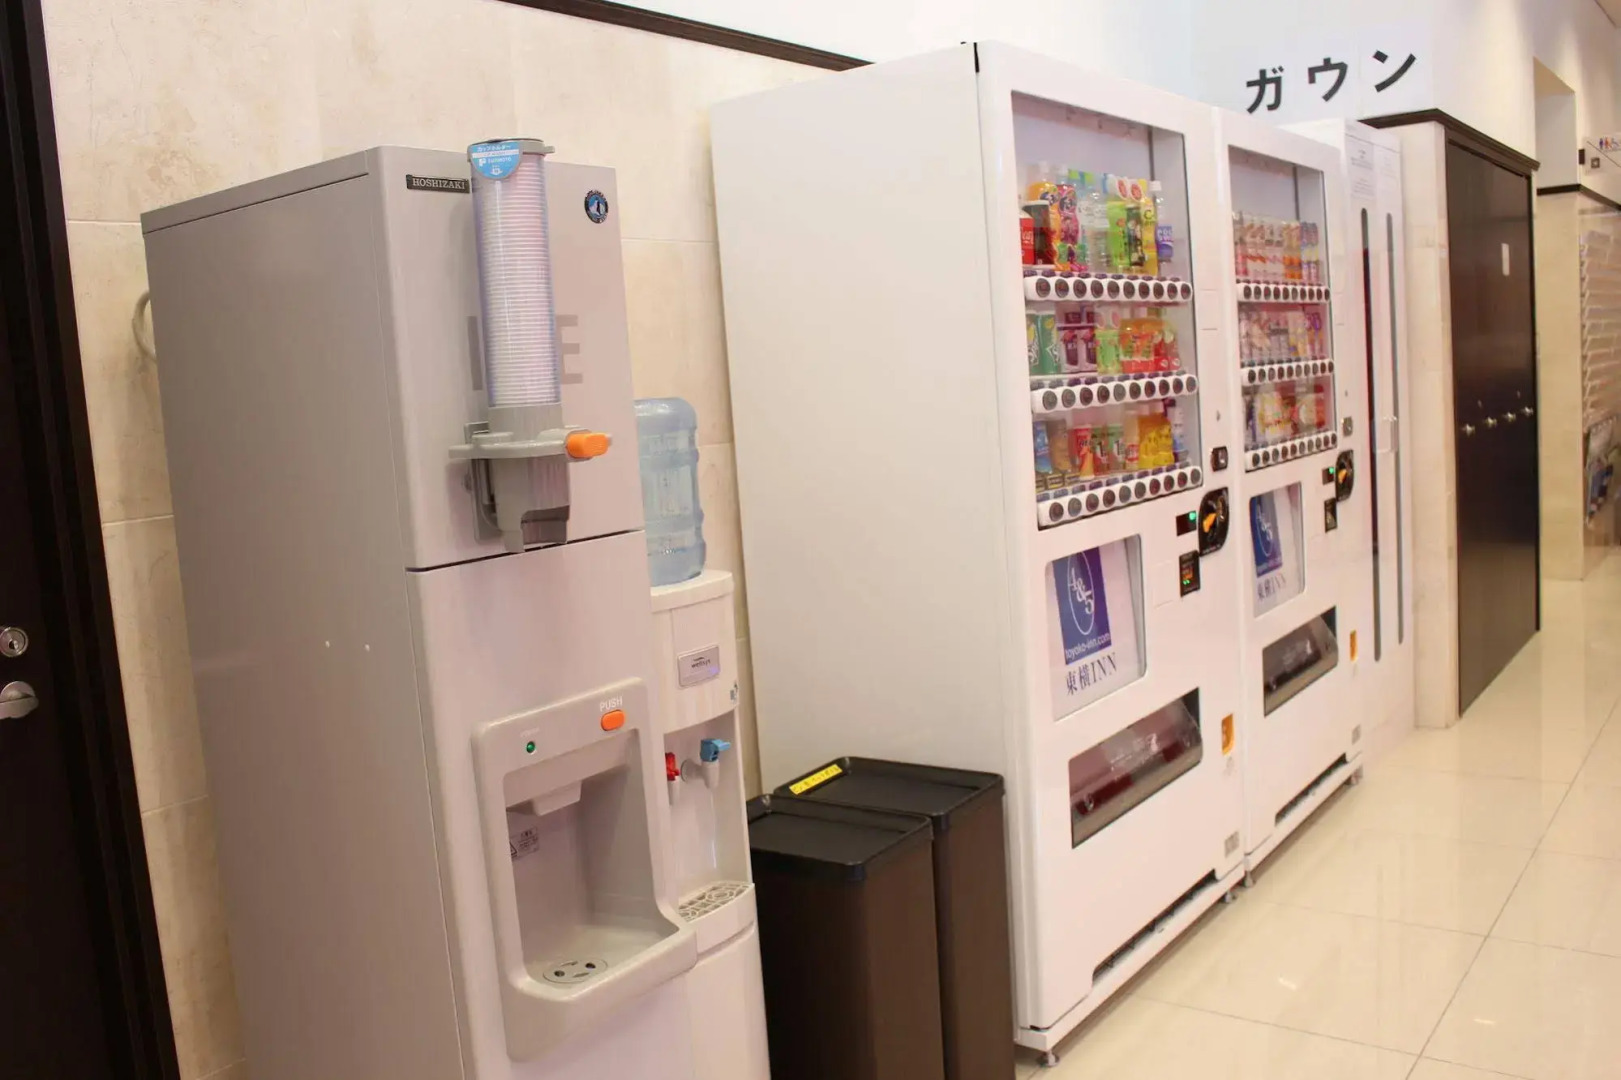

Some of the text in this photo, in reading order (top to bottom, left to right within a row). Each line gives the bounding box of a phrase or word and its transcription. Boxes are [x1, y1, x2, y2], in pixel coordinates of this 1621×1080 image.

[1246, 50, 1416, 114] ガウン
[412, 178, 466, 190] HOSHIZAKI
[1065, 632, 1110, 660] toyoko-inn.com
[1064, 651, 1117, 697] 東横INN
[600, 694, 623, 713] PUSH
